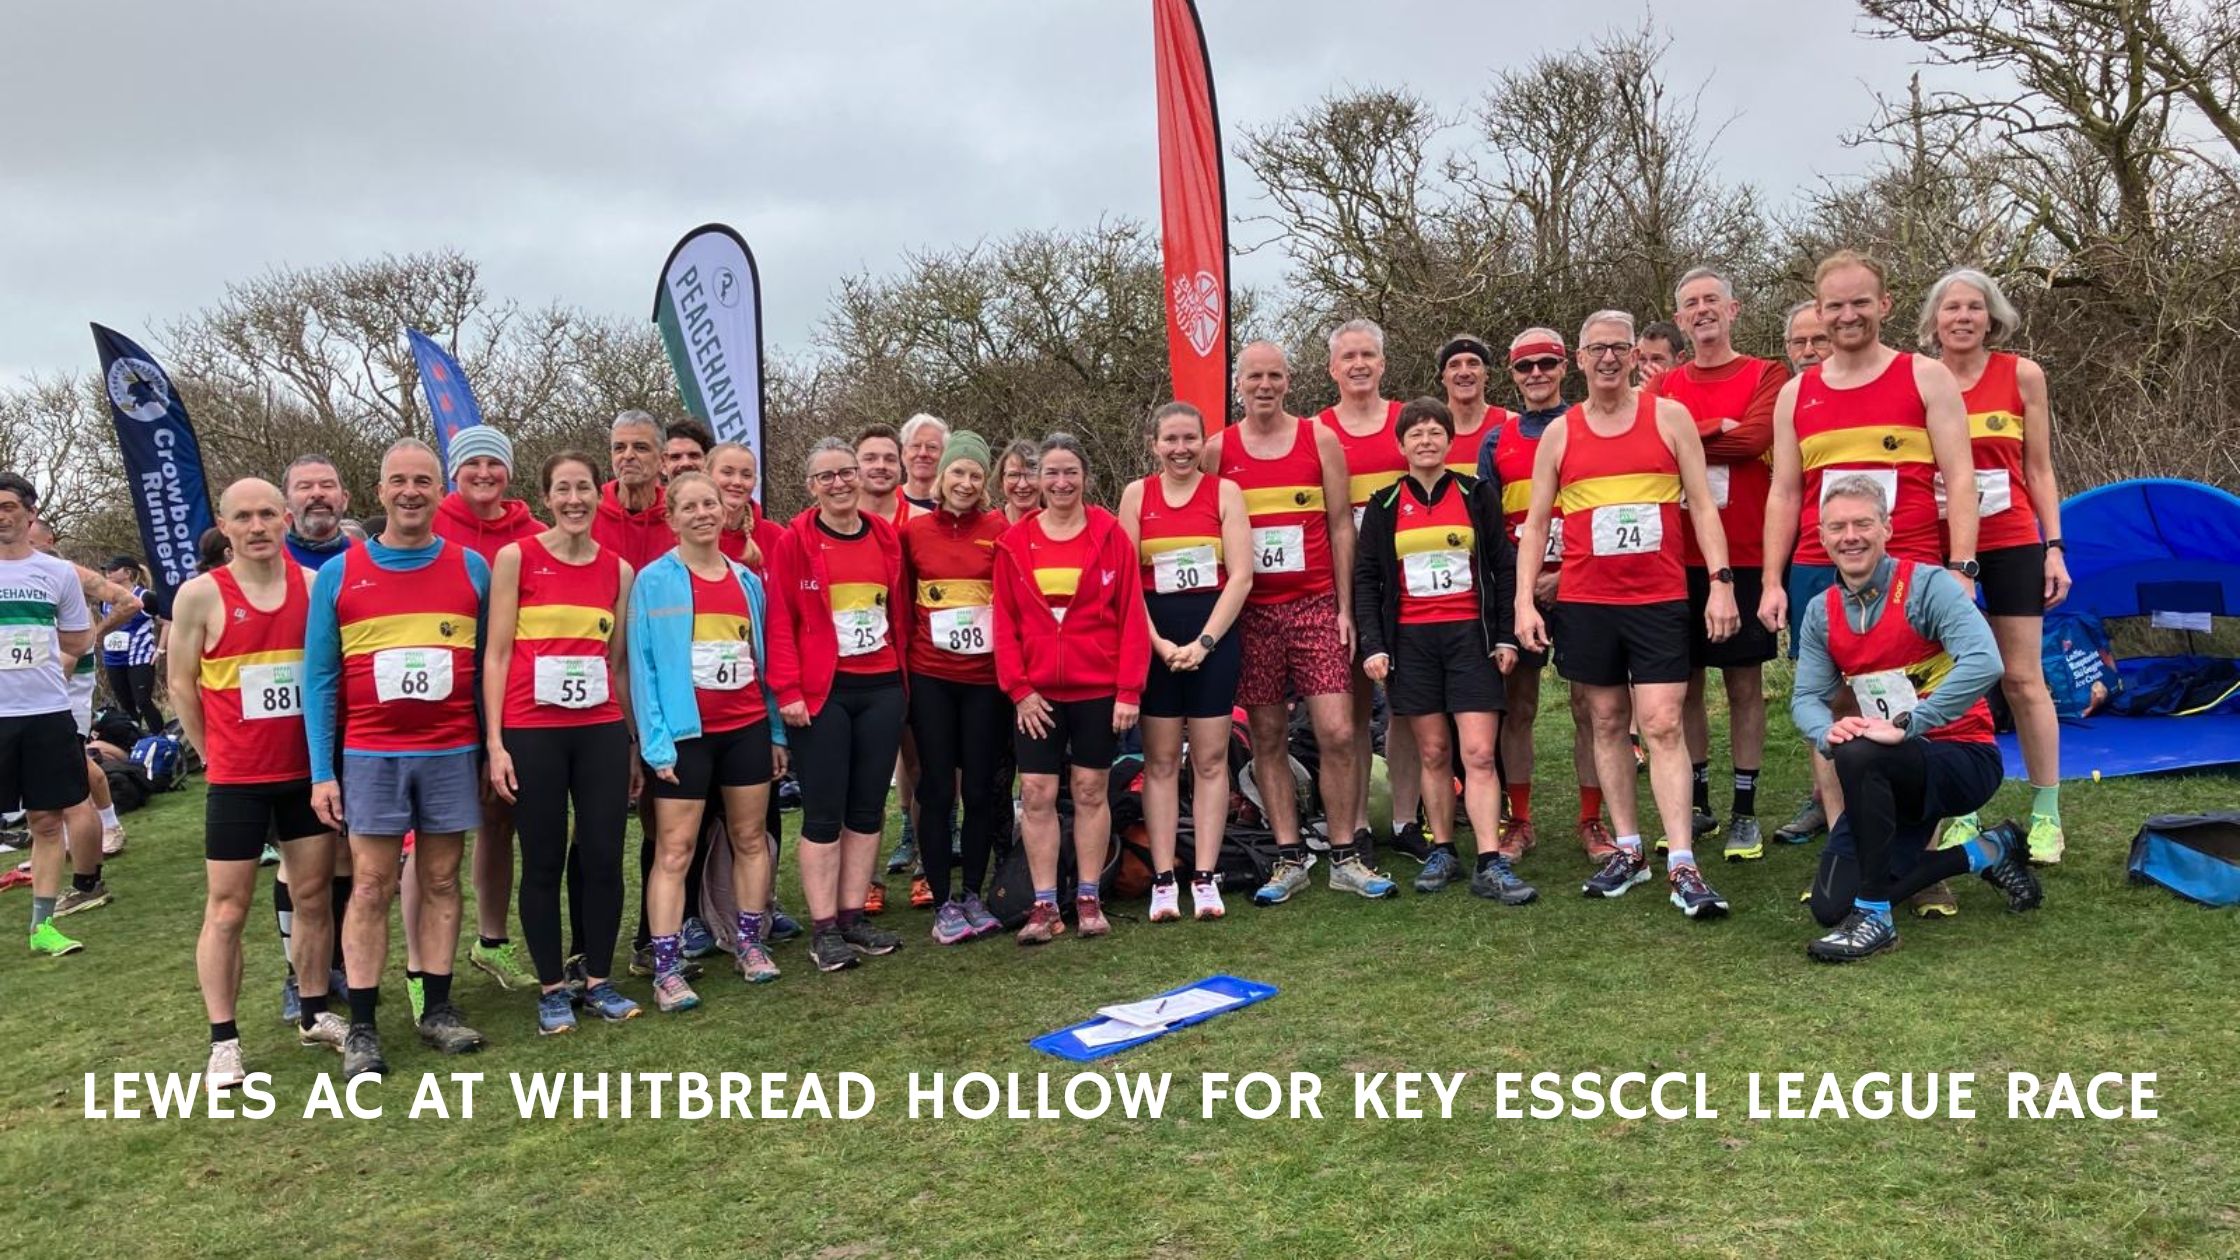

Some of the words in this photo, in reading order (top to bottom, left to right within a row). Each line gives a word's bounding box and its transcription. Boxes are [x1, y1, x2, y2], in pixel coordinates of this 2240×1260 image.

[141, 470, 181, 587] Runners
[1616, 525, 1642, 549] 24
[1262, 547, 1285, 568] 64
[1175, 567, 1199, 589] 30
[1432, 569, 1453, 590] 13
[0, 588, 47, 600] EHAVEN
[854, 627, 876, 649] 25
[949, 626, 985, 651] 898
[11, 647, 33, 665] 94
[401, 671, 429, 695] 68
[716, 662, 737, 684] 61
[263, 685, 301, 712] 881
[561, 679, 587, 702] 55
[1876, 698, 1890, 720] 9
